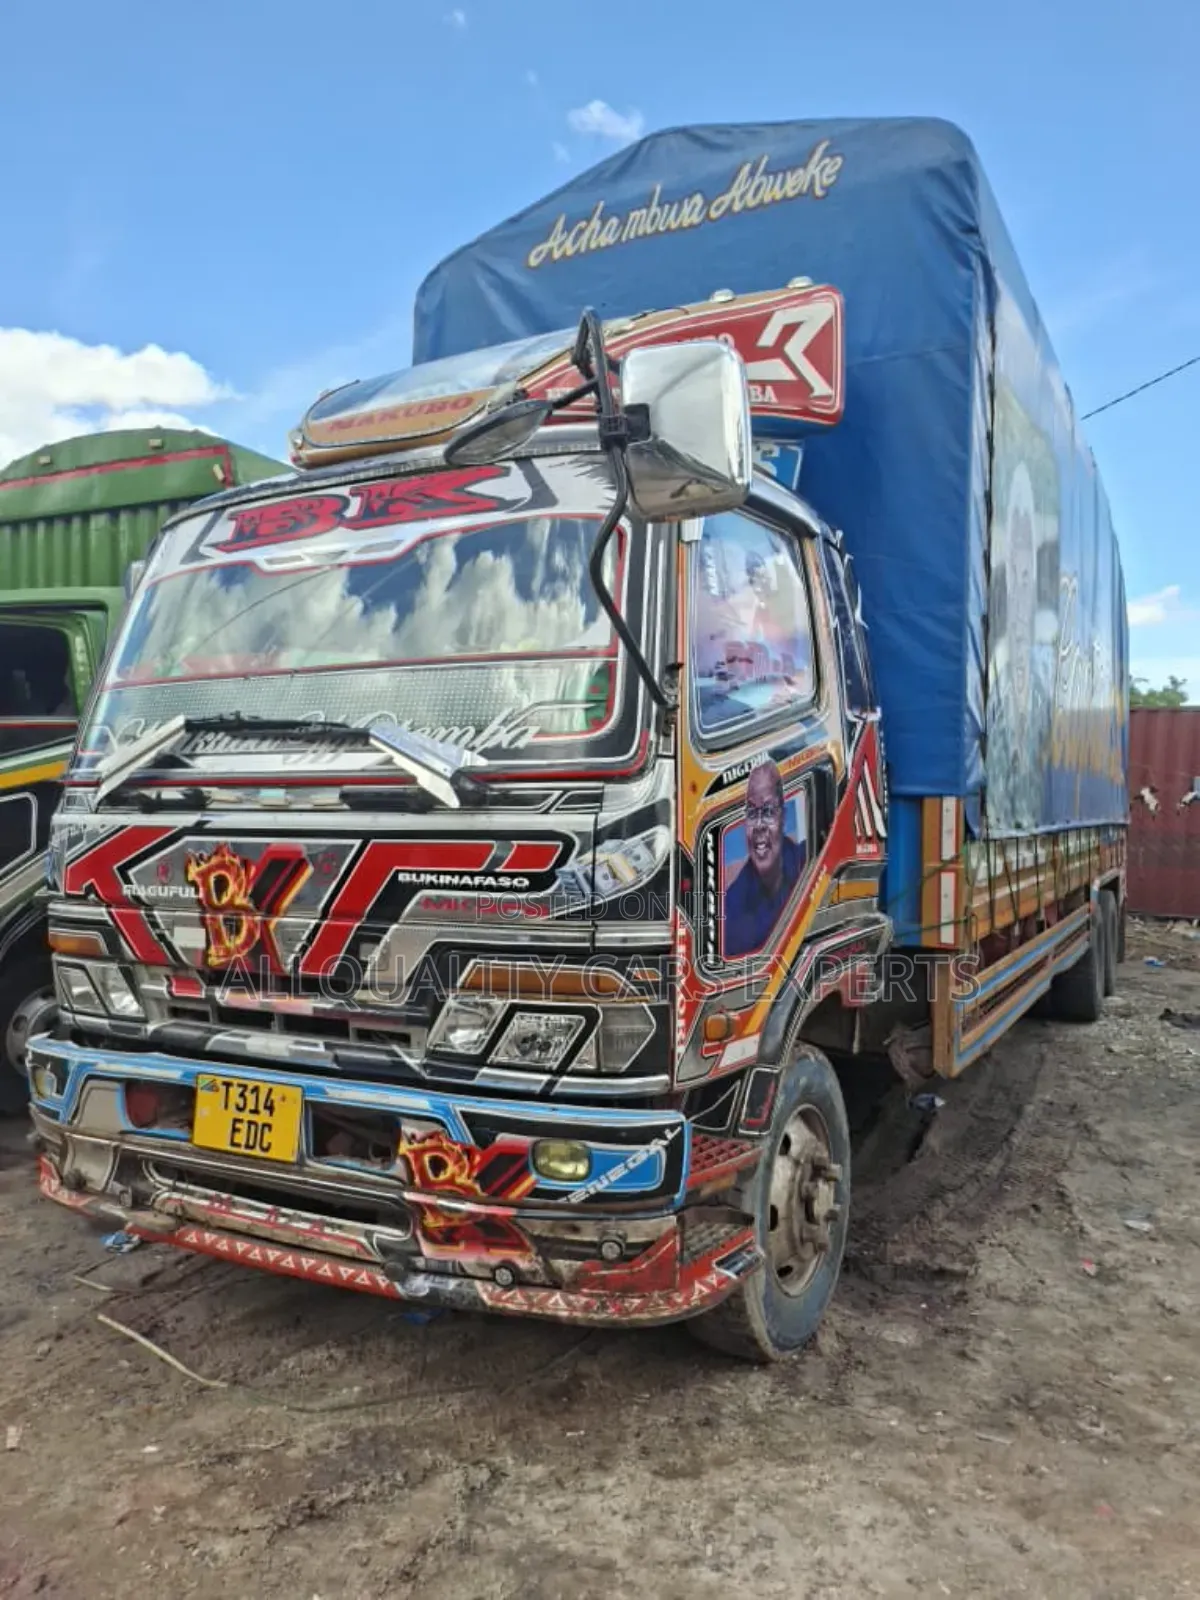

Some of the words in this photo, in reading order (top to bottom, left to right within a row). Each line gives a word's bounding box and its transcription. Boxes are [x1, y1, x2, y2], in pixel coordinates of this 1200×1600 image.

[397, 872, 530, 888] BUKINAFASO
[221, 1081, 275, 1117] T314
[229, 1117, 273, 1154] EDC
